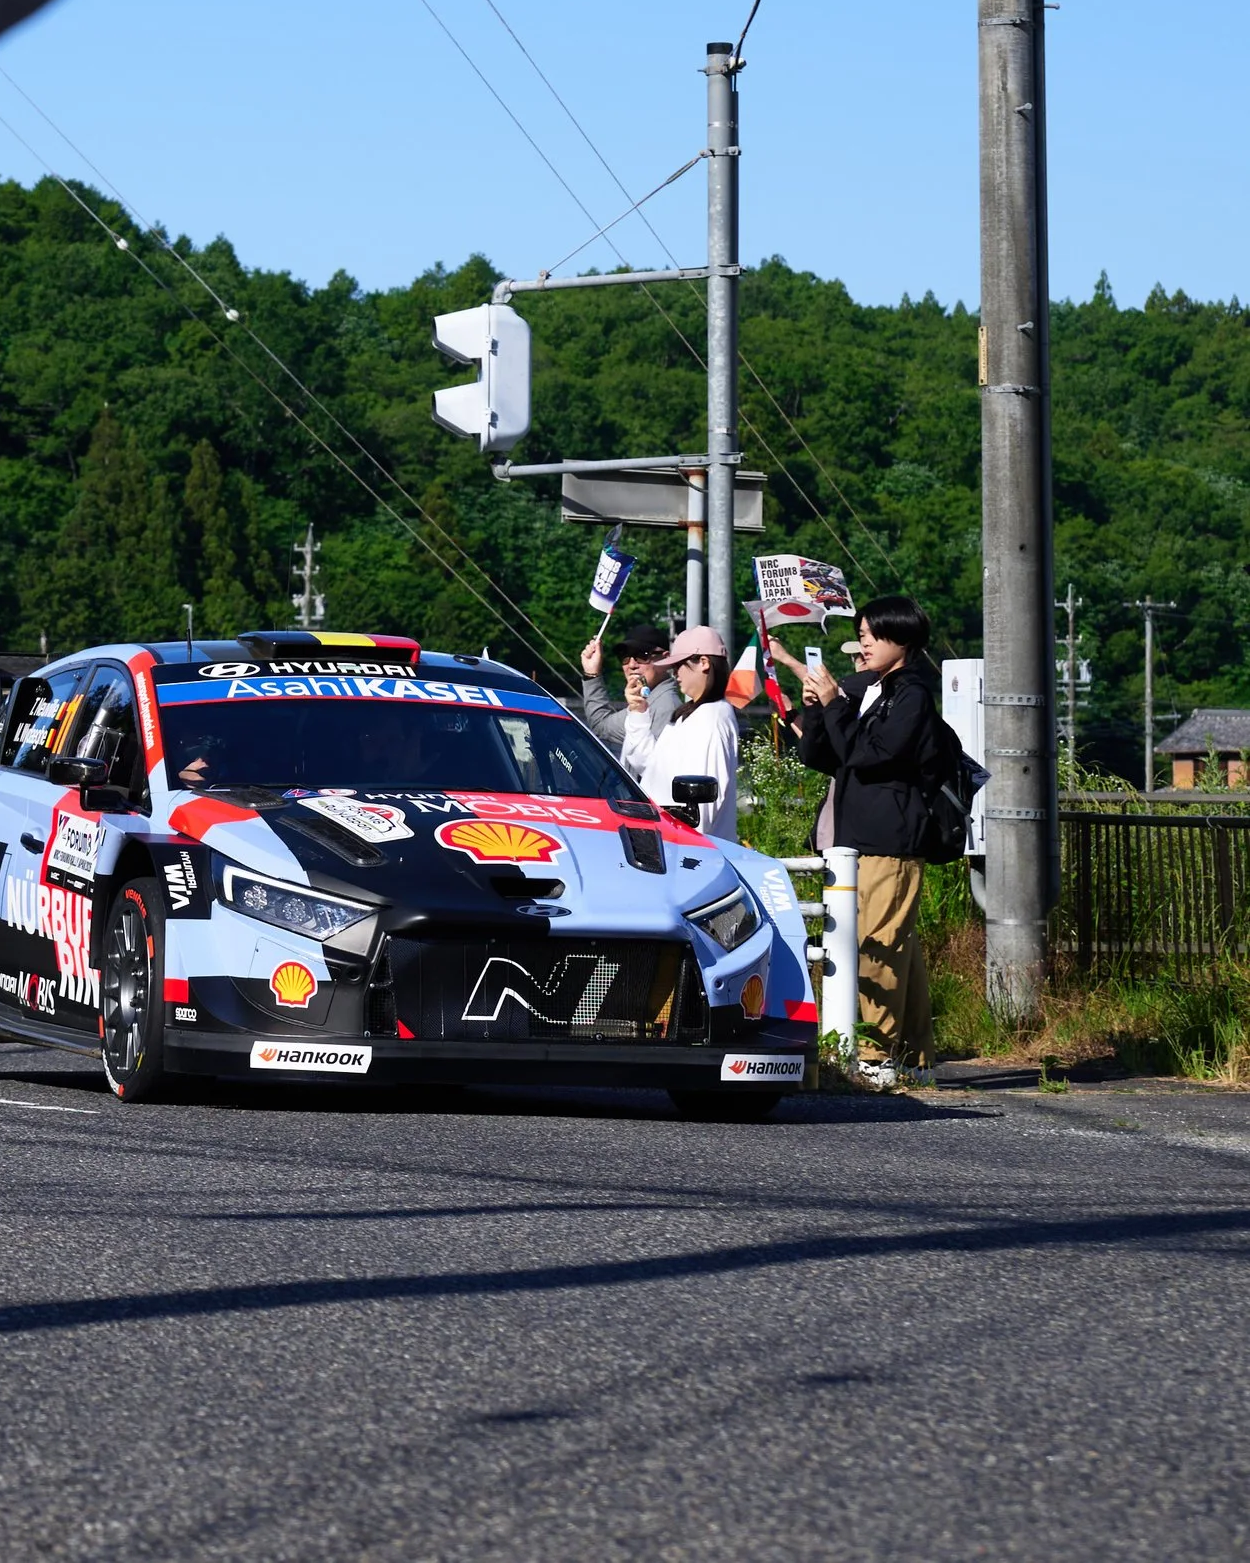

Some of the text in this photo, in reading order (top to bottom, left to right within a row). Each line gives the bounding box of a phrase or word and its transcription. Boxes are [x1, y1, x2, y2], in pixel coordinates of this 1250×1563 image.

[759, 559, 779, 570] WRC
[761, 566, 798, 579] FORUM8
[763, 577, 790, 588] RALLY
[765, 587, 792, 598] JAPAN
[270, 661, 418, 678] HYUNDAI
[365, 793, 498, 802] HYUNDAI
[407, 799, 602, 824] MOBIS
[179, 851, 198, 889] HYUNDAI
[17, 970, 57, 1016] MOBIS
[175, 1006, 197, 1021] sparco
